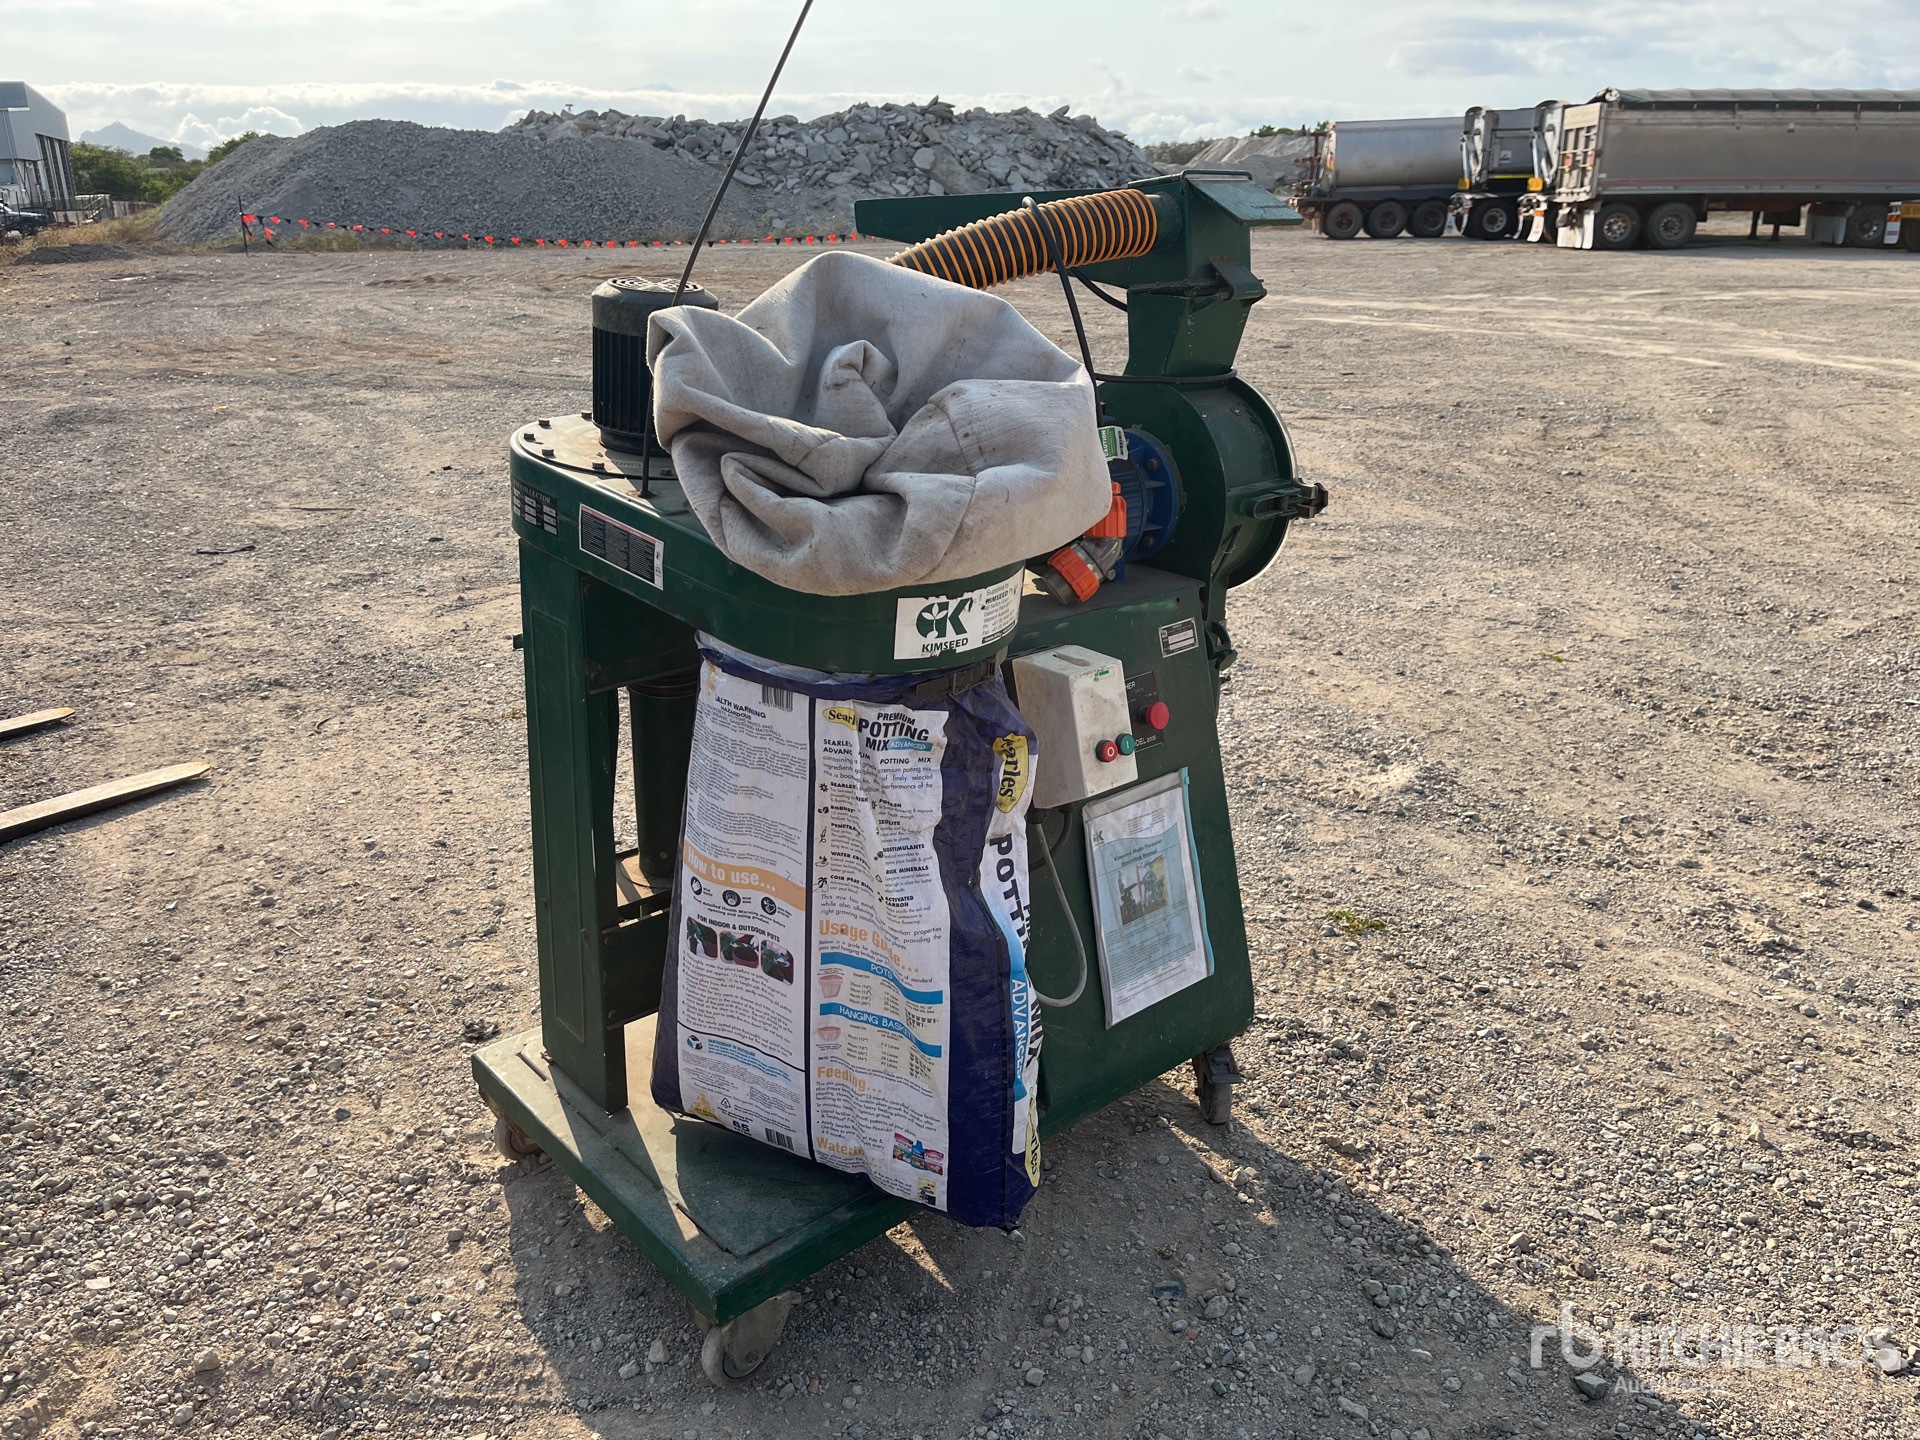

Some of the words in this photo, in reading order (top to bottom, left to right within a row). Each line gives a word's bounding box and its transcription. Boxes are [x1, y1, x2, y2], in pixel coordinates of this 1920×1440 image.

[987, 585, 1005, 596] Supplied
[921, 637, 969, 653] KIMSEED
[720, 706, 752, 720] HAZARDOUS
[733, 702, 767, 719] WARNING
[876, 711, 916, 726] PREMIUM
[755, 727, 782, 738] MATERIALS
[857, 717, 930, 742] POTTING
[823, 738, 853, 748] SEARLES
[865, 736, 890, 752] MIX
[889, 741, 926, 750] ADVANCED
[822, 755, 853, 765] containing
[881, 774, 888, 782] of
[892, 774, 908, 782] finely
[911, 773, 933, 781] selected
[881, 782, 917, 790] performance
[917, 781, 924, 789] of
[925, 781, 933, 789] the
[878, 798, 902, 808] POTASH
[830, 805, 854, 813] ROBUST
[830, 850, 851, 858] WATER
[1142, 848, 1158, 857] Manual
[688, 846, 708, 875] How
[710, 862, 726, 881] to
[730, 870, 777, 893] use...
[898, 865, 929, 874] MINERALS
[884, 895, 914, 903] ACTIVATED
[702, 901, 721, 910] detailed
[738, 909, 759, 917] Warning
[759, 913, 772, 921] above
[772, 918, 786, 928] before
[707, 907, 726, 916] opening
[820, 908, 835, 916] right
[835, 909, 858, 920] growing
[839, 901, 851, 909] also
[852, 905, 874, 918] allowing
[697, 913, 708, 924] FOR
[708, 918, 731, 929] INDOOR
[738, 924, 766, 936] OUTDOOR
[766, 931, 780, 943] POTS
[819, 919, 868, 942] Usage
[913, 927, 942, 937] properties
[903, 936, 931, 944] providing
[840, 945, 860, 956] hanging
[870, 963, 893, 980] POTS
[839, 1005, 879, 1025] HANGING
[881, 1018, 918, 1044] BASKETS
[817, 1066, 882, 1092] Feeding...
[863, 1104, 877, 1112] heavy
[877, 1106, 894, 1117] feeding
[894, 1112, 907, 1120] plants
[914, 1121, 924, 1129] need
[732, 1120, 751, 1132] 65
[820, 1125, 840, 1133] Gardens
